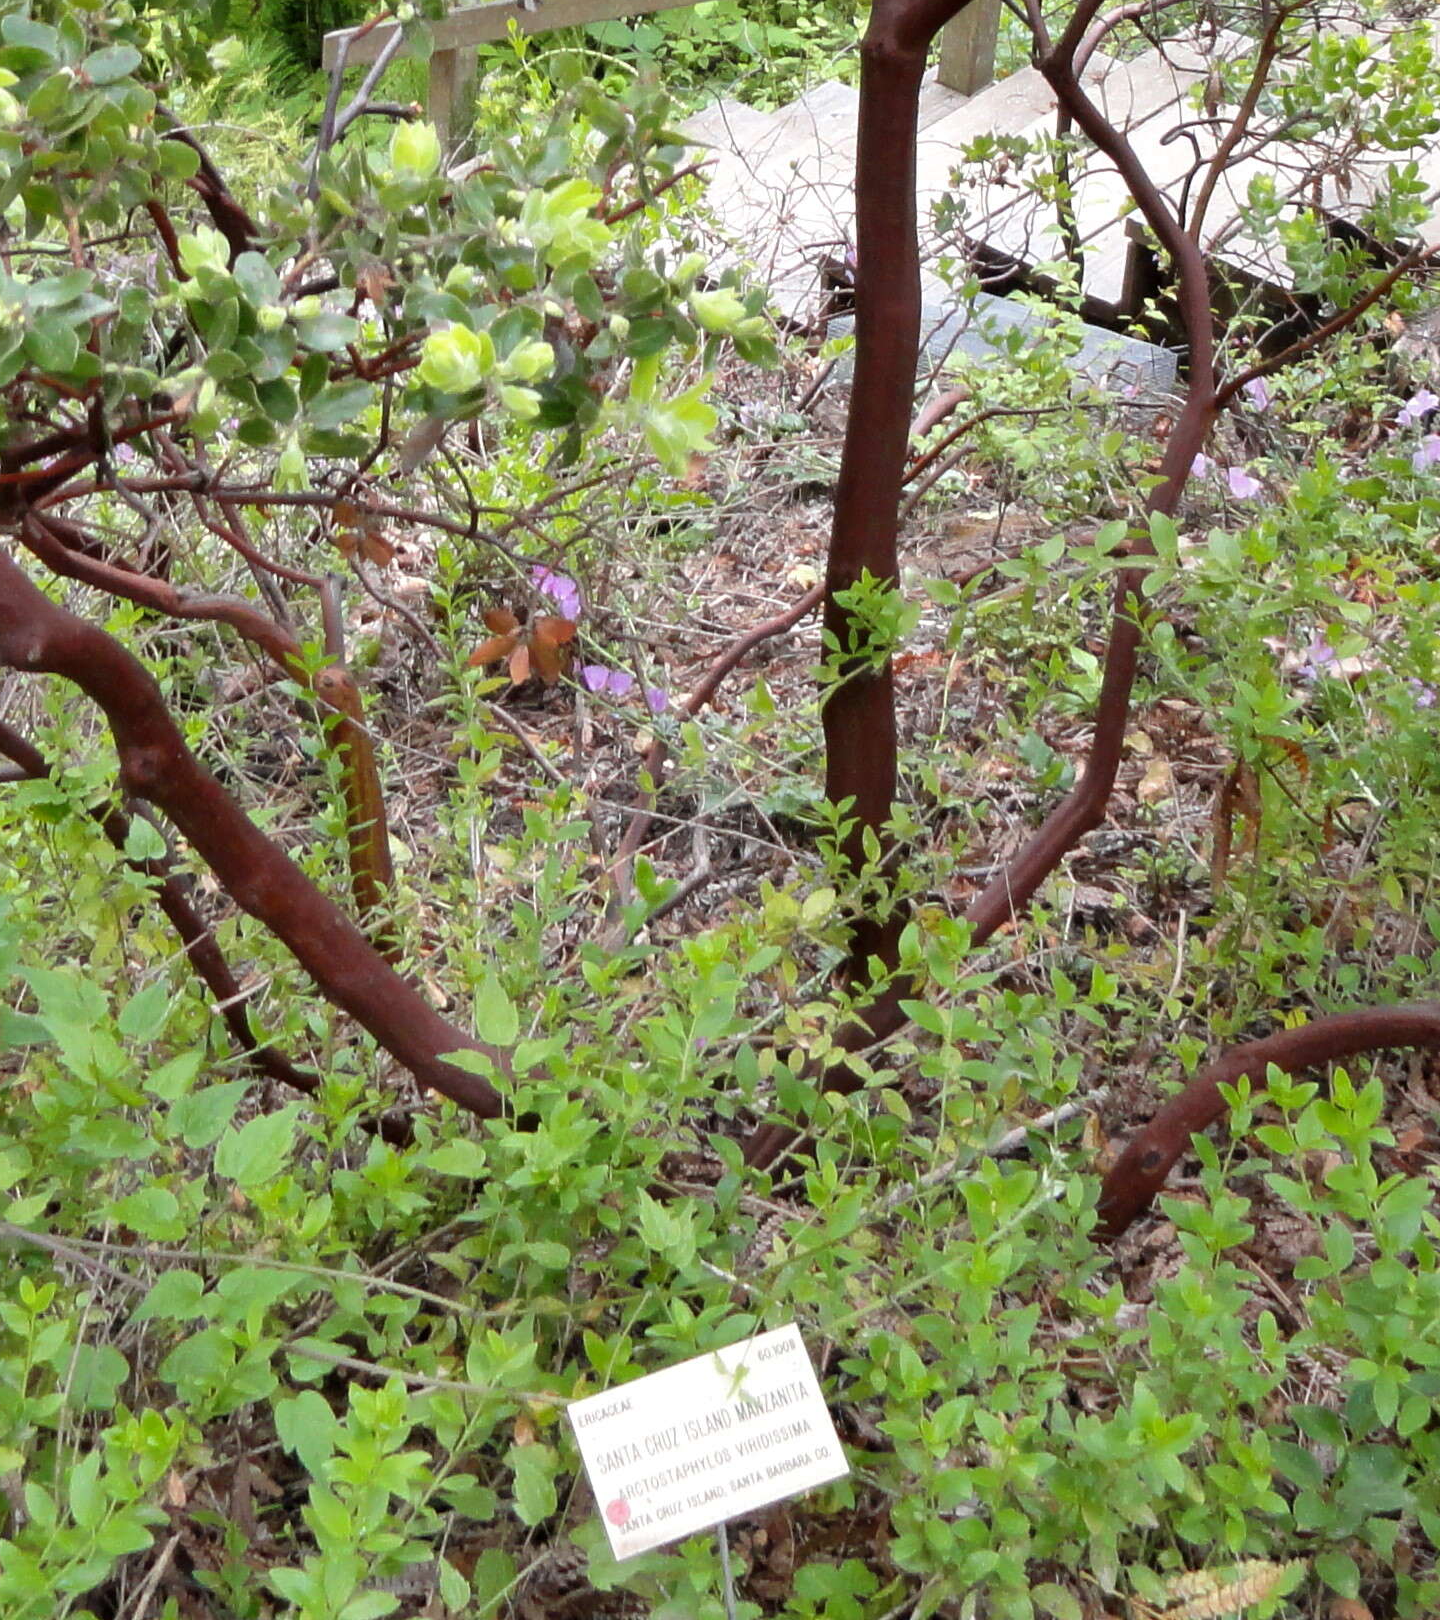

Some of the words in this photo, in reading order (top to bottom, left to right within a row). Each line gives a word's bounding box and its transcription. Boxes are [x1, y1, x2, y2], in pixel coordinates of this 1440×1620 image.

[596, 1443, 642, 1475] SANTA
[645, 1429, 679, 1457] CRUZ
[683, 1409, 732, 1443] ISLAND
[735, 1382, 809, 1422] MANZANITA
[618, 1449, 732, 1500] ARCTOSTAPHYLOS
[736, 1420, 811, 1457] VIRIDISSIMA
[619, 1514, 653, 1536] SANTA
[656, 1502, 683, 1521] CRUZ
[731, 1472, 762, 1495] SANTA
[766, 1454, 811, 1480] BARBARA
